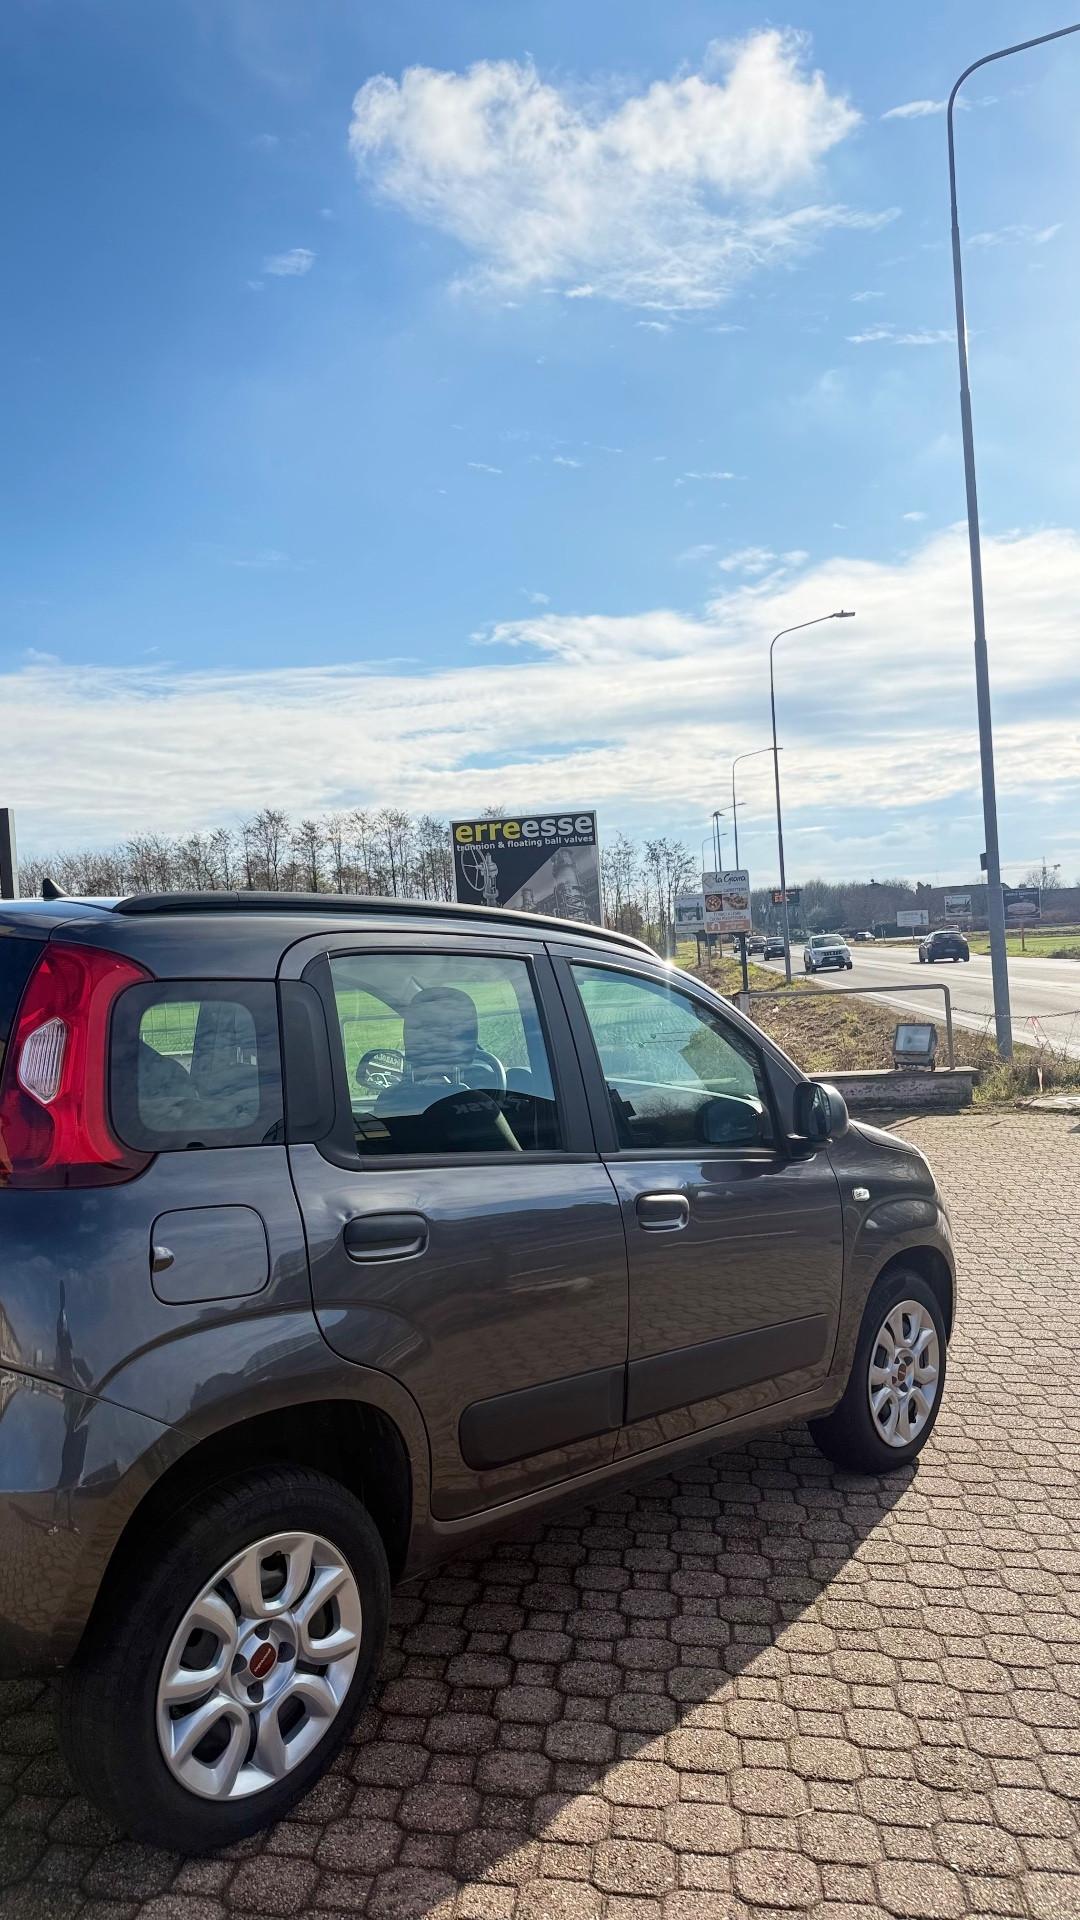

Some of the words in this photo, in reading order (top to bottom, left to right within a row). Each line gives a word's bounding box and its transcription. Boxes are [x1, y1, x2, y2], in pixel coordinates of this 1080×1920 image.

[455, 815, 593, 843] erreesse
[456, 843, 495, 852] trunnion
[507, 838, 542, 848] floating
[545, 836, 561, 844] ball
[564, 835, 593, 844] valves
